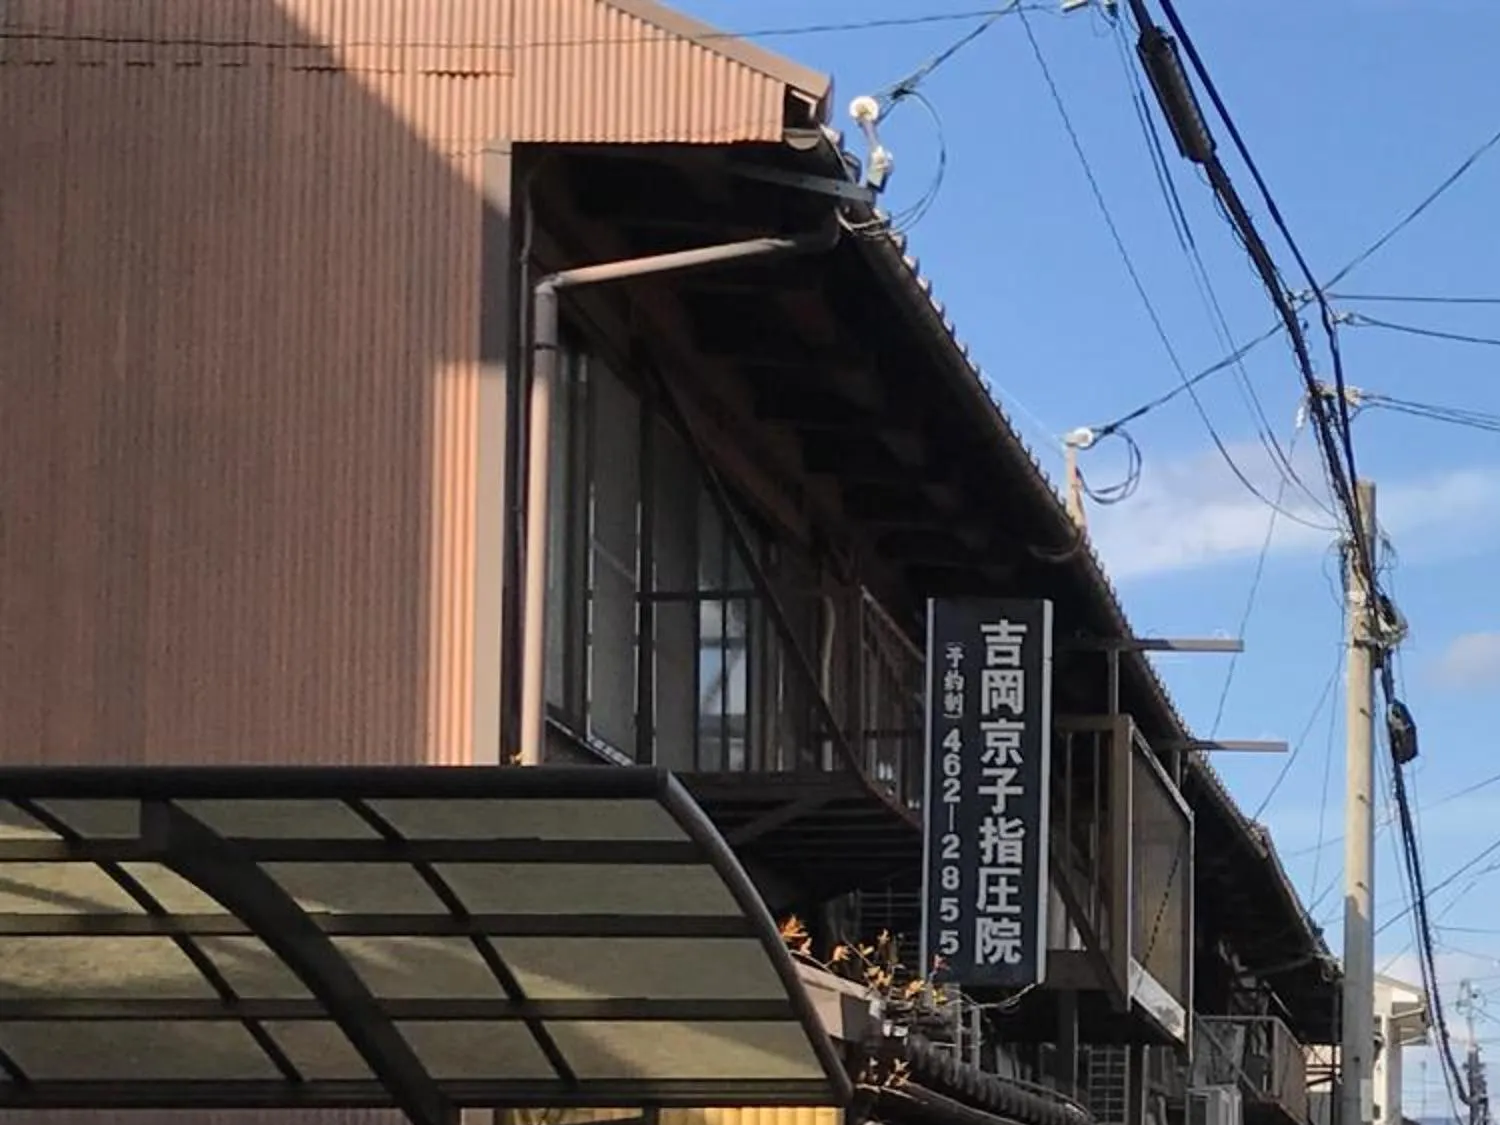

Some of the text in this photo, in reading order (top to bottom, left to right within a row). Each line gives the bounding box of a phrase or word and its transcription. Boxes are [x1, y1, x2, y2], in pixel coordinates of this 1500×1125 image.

[975, 619, 1028, 966] 吉岡京子指圧院
